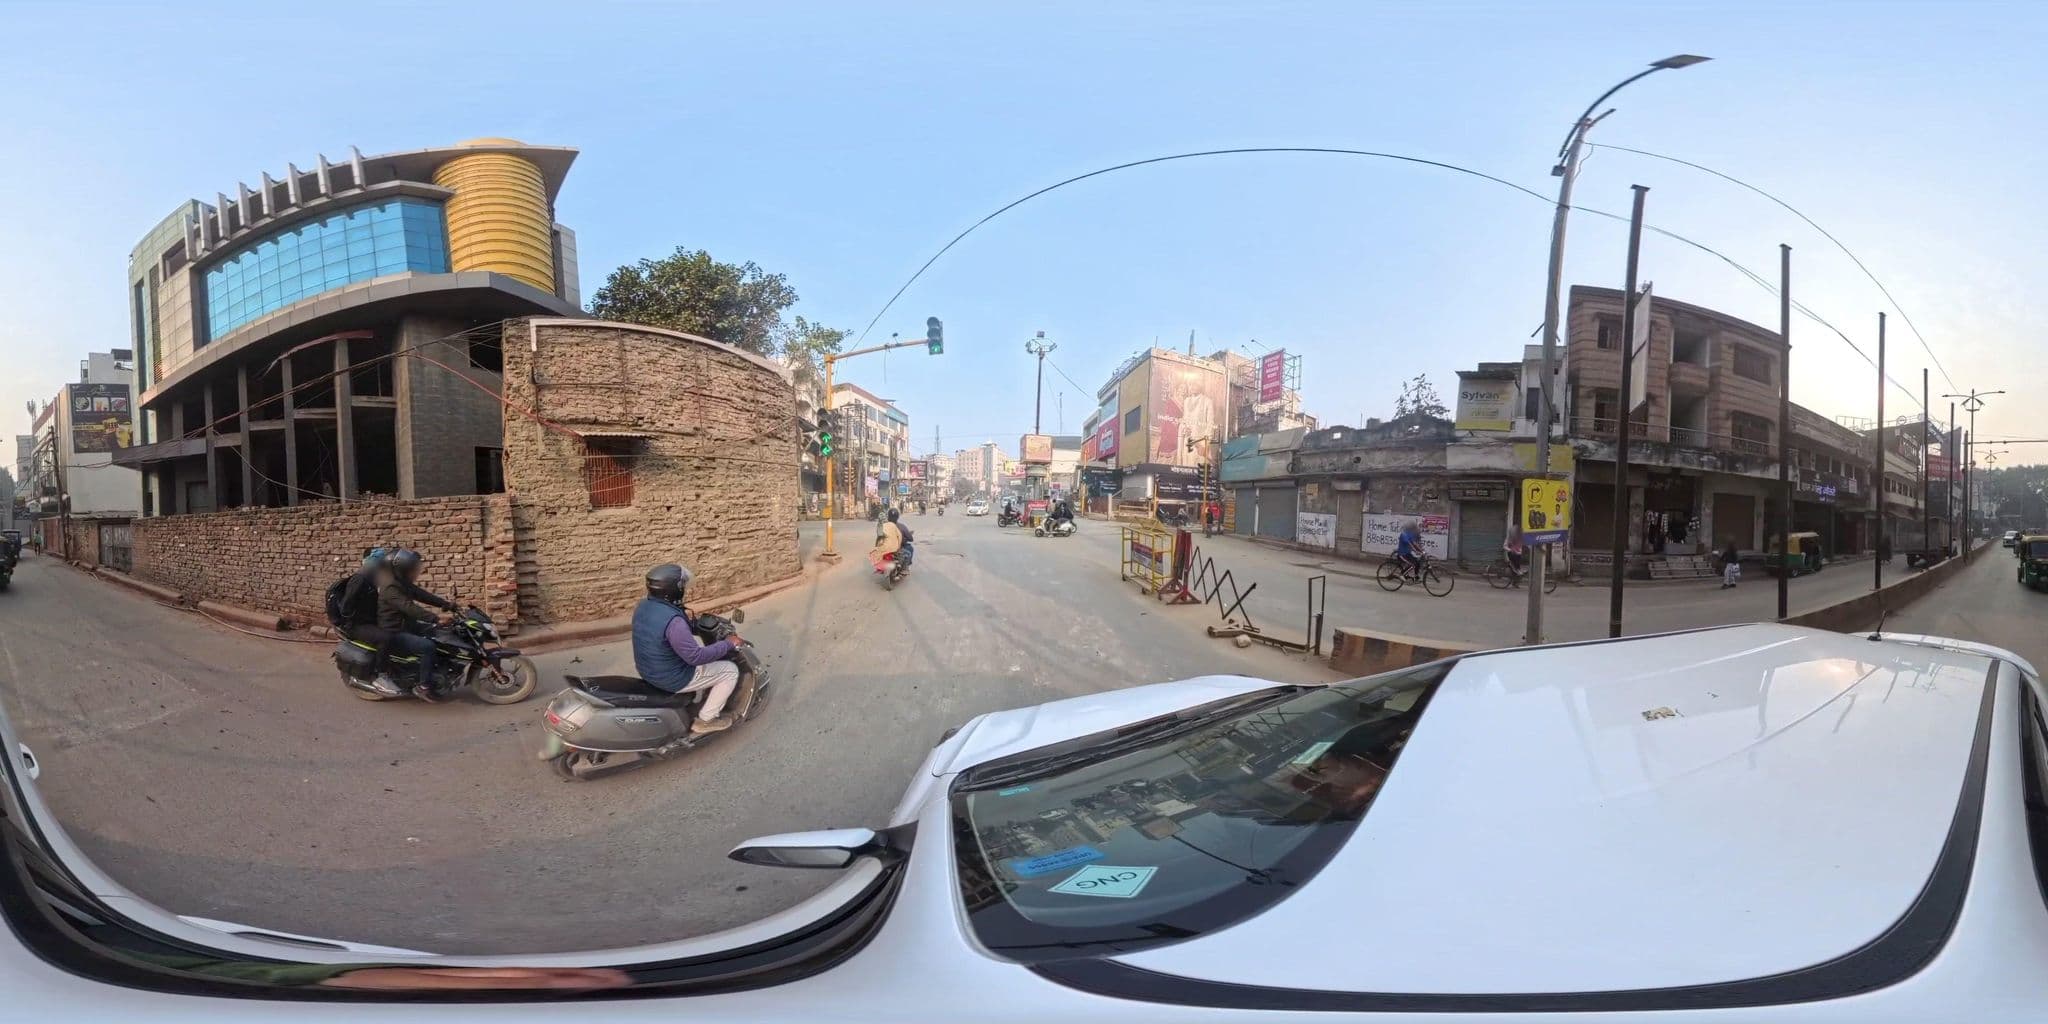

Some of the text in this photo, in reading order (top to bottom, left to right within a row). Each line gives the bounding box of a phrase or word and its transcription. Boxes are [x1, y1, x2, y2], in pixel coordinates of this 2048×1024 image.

[1462, 390, 1500, 401] Sylvan
[1368, 519, 1387, 532] Home
[1076, 871, 1137, 889] CNG
